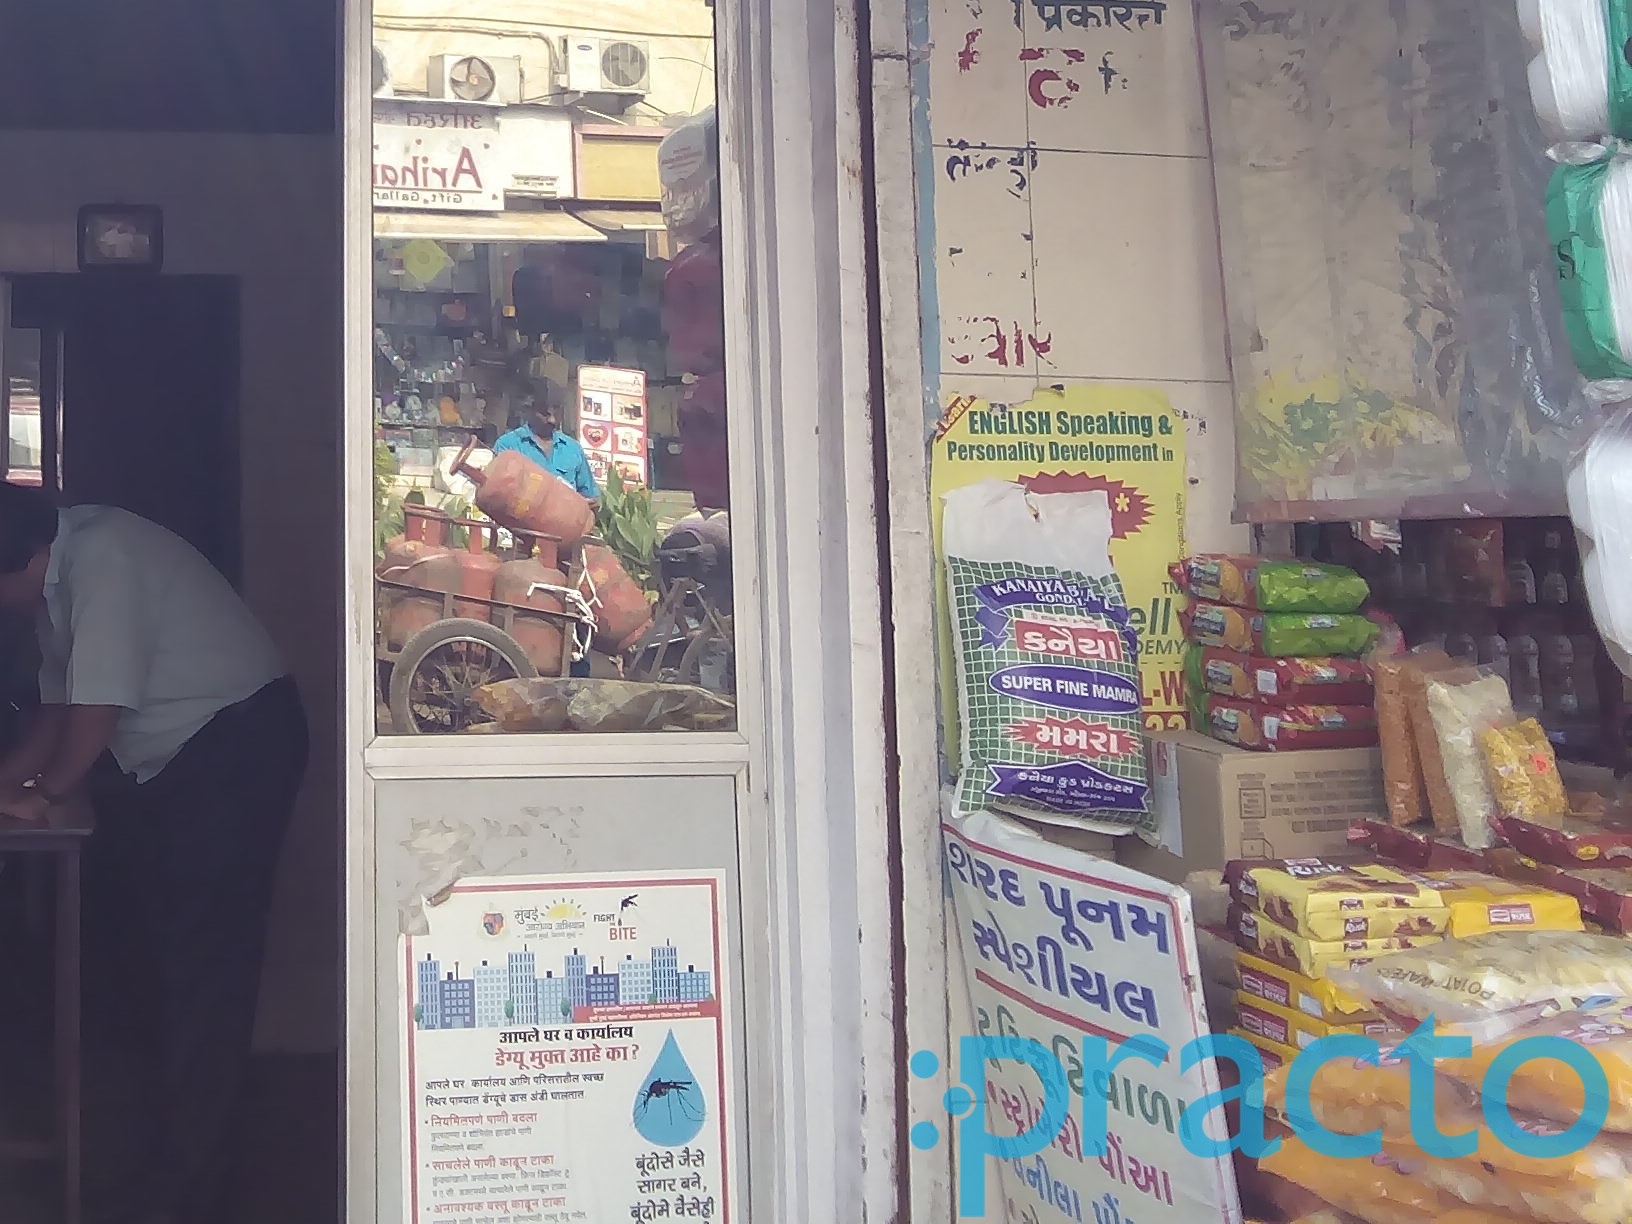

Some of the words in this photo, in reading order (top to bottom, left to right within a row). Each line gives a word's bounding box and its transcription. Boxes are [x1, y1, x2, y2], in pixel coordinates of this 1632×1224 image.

[969, 411, 1051, 436] ENGLISH
[1056, 410, 1153, 437] Speaking
[1158, 415, 1173, 435] &
[947, 441, 1045, 463] Personality
[1049, 441, 1158, 463] Development
[1162, 447, 1174, 462] in
[992, 579, 1066, 596] KANAIYA
[1129, 598, 1172, 635] ell
[1001, 675, 1053, 693] SUPER
[1056, 680, 1089, 697] FINE
[1035, 725, 1118, 753] મમરા
[949, 842, 1026, 907] શરદ
[1039, 880, 1169, 954] પૂનમ
[609, 927, 637, 941] BITE
[499, 1027, 540, 1043] आपले
[543, 1029, 561, 1041] घर
[564, 1029, 574, 1040] व
[576, 1024, 634, 1039] कार्यालय
[529, 1049, 566, 1070] मुक्त
[570, 1043, 603, 1063] आहे
[677, 1147, 705, 1168] जैसे
[636, 1178, 677, 1194] सागर
